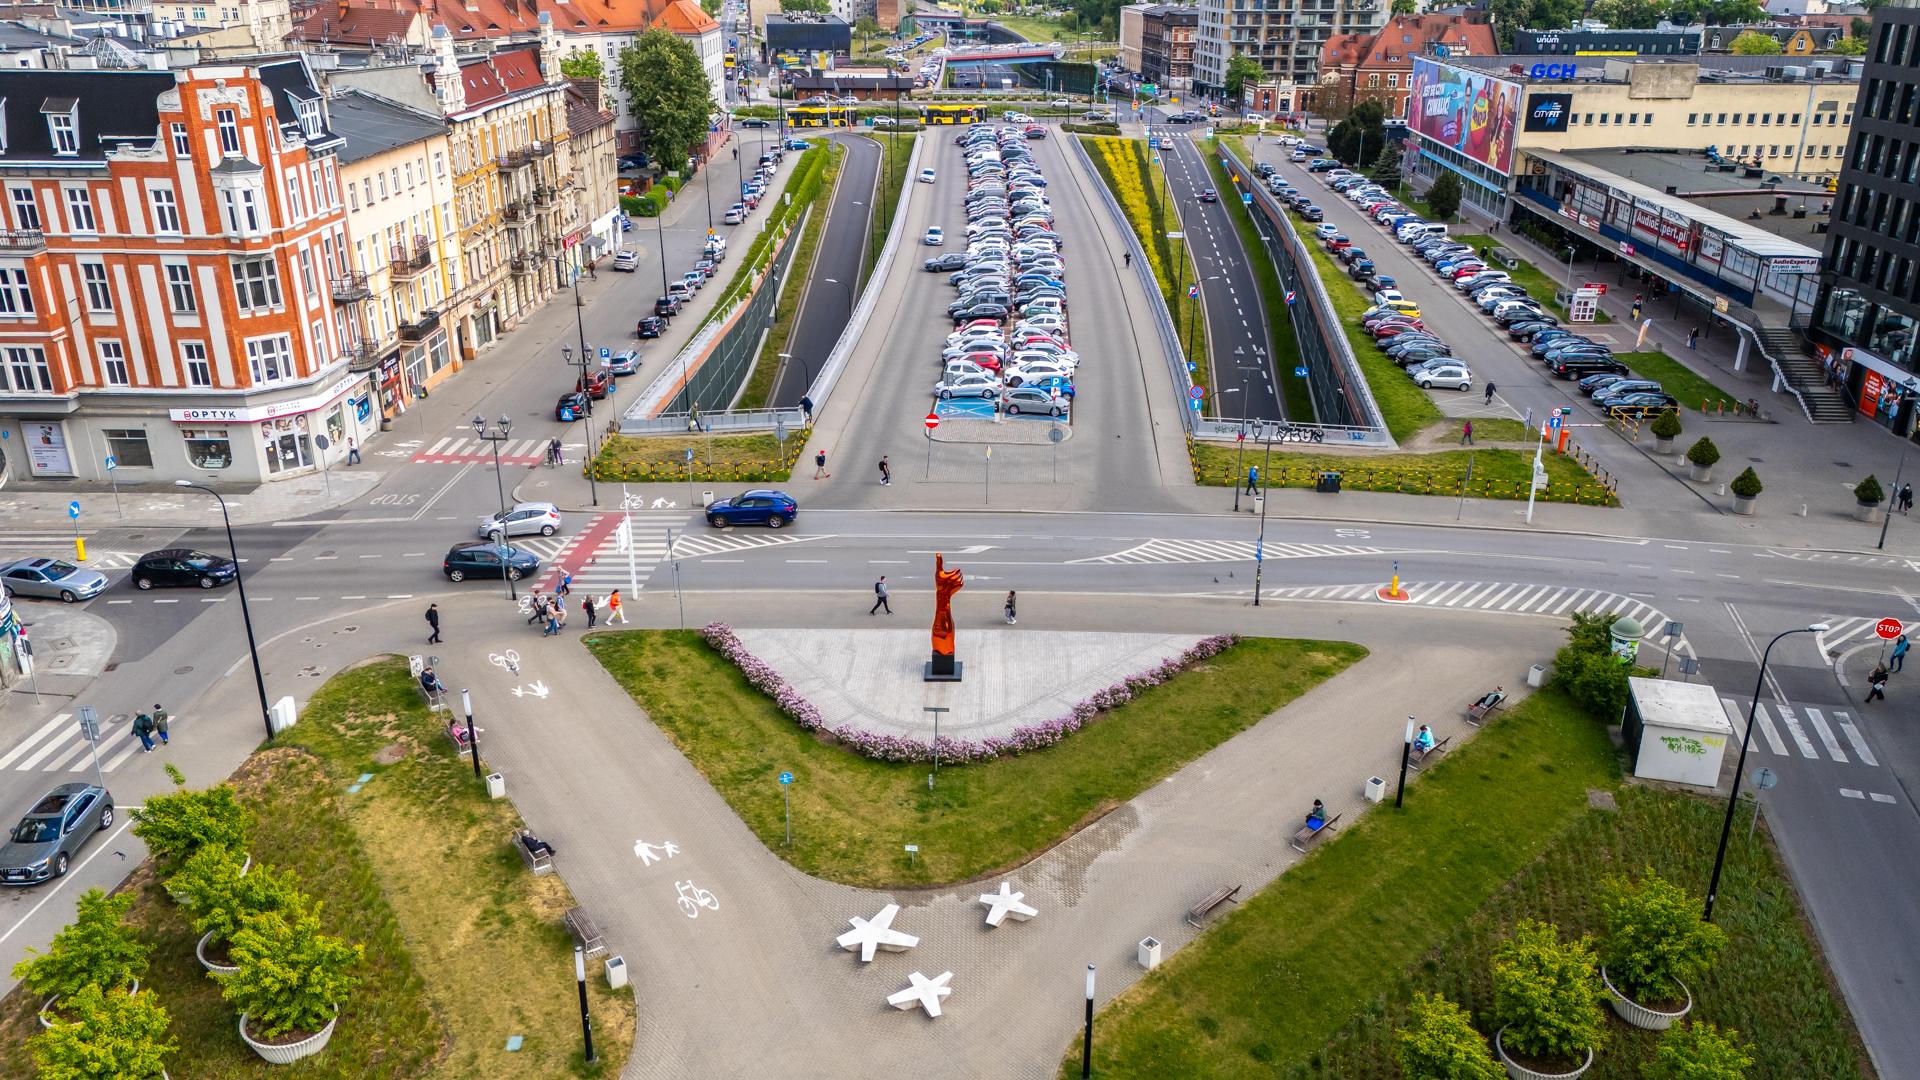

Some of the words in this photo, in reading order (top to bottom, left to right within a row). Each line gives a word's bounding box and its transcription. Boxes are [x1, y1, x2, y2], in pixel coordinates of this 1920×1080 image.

[1531, 64, 1576, 78] GCH
[1636, 211, 1687, 243] AudioEpert.pl
[1053, 378, 1059, 386] P
[370, 494, 420, 505] STOP
[1879, 624, 1900, 633] STOP
